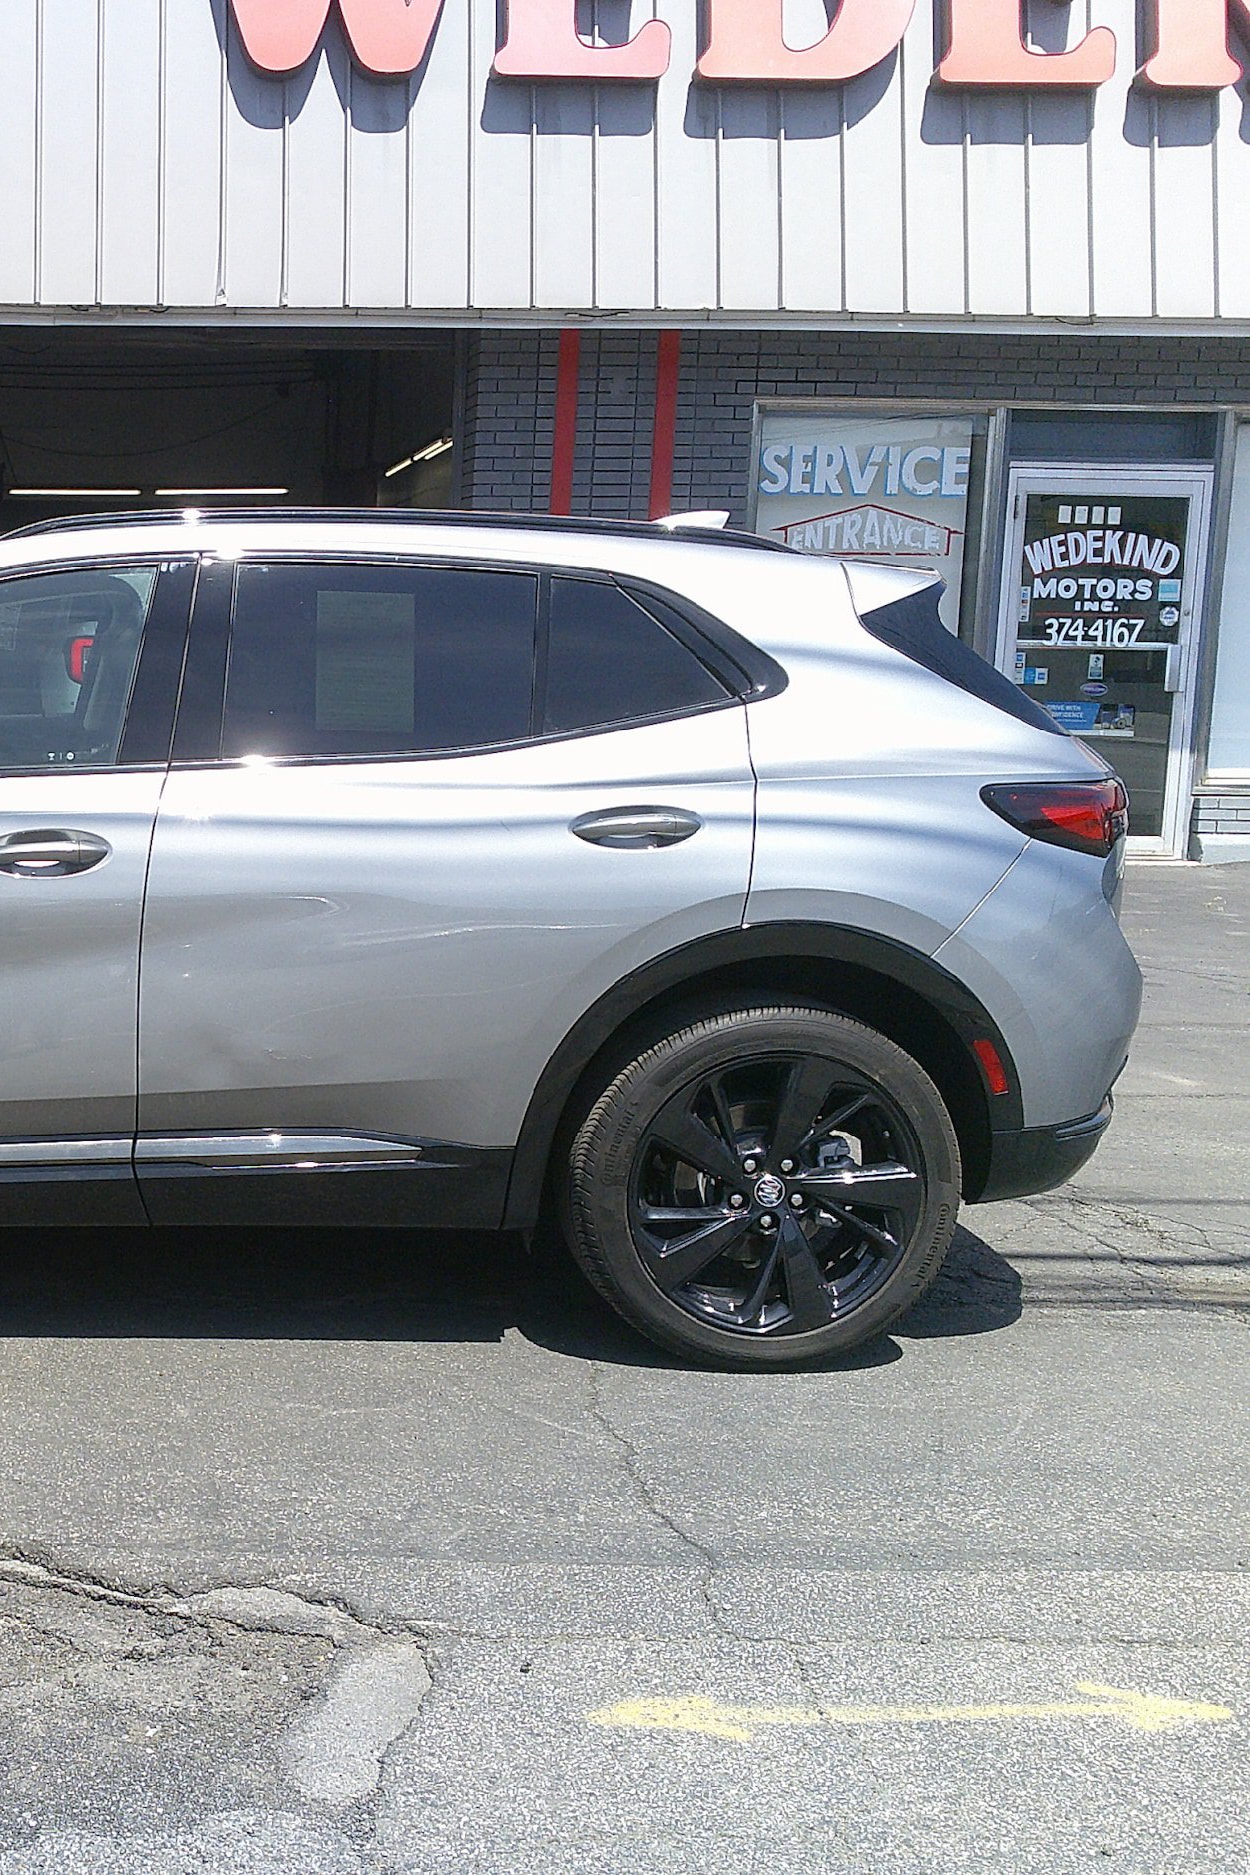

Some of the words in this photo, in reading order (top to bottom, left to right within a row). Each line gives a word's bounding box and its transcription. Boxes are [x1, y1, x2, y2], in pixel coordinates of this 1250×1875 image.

[759, 445, 971, 496] SERVICE
[791, 510, 940, 550] ENTRANCE
[1024, 530, 1181, 576] WEDEKIND
[1033, 577, 1153, 601] MOTORS
[1074, 600, 1119, 612] INC.
[1044, 618, 1146, 647] 374-4167
